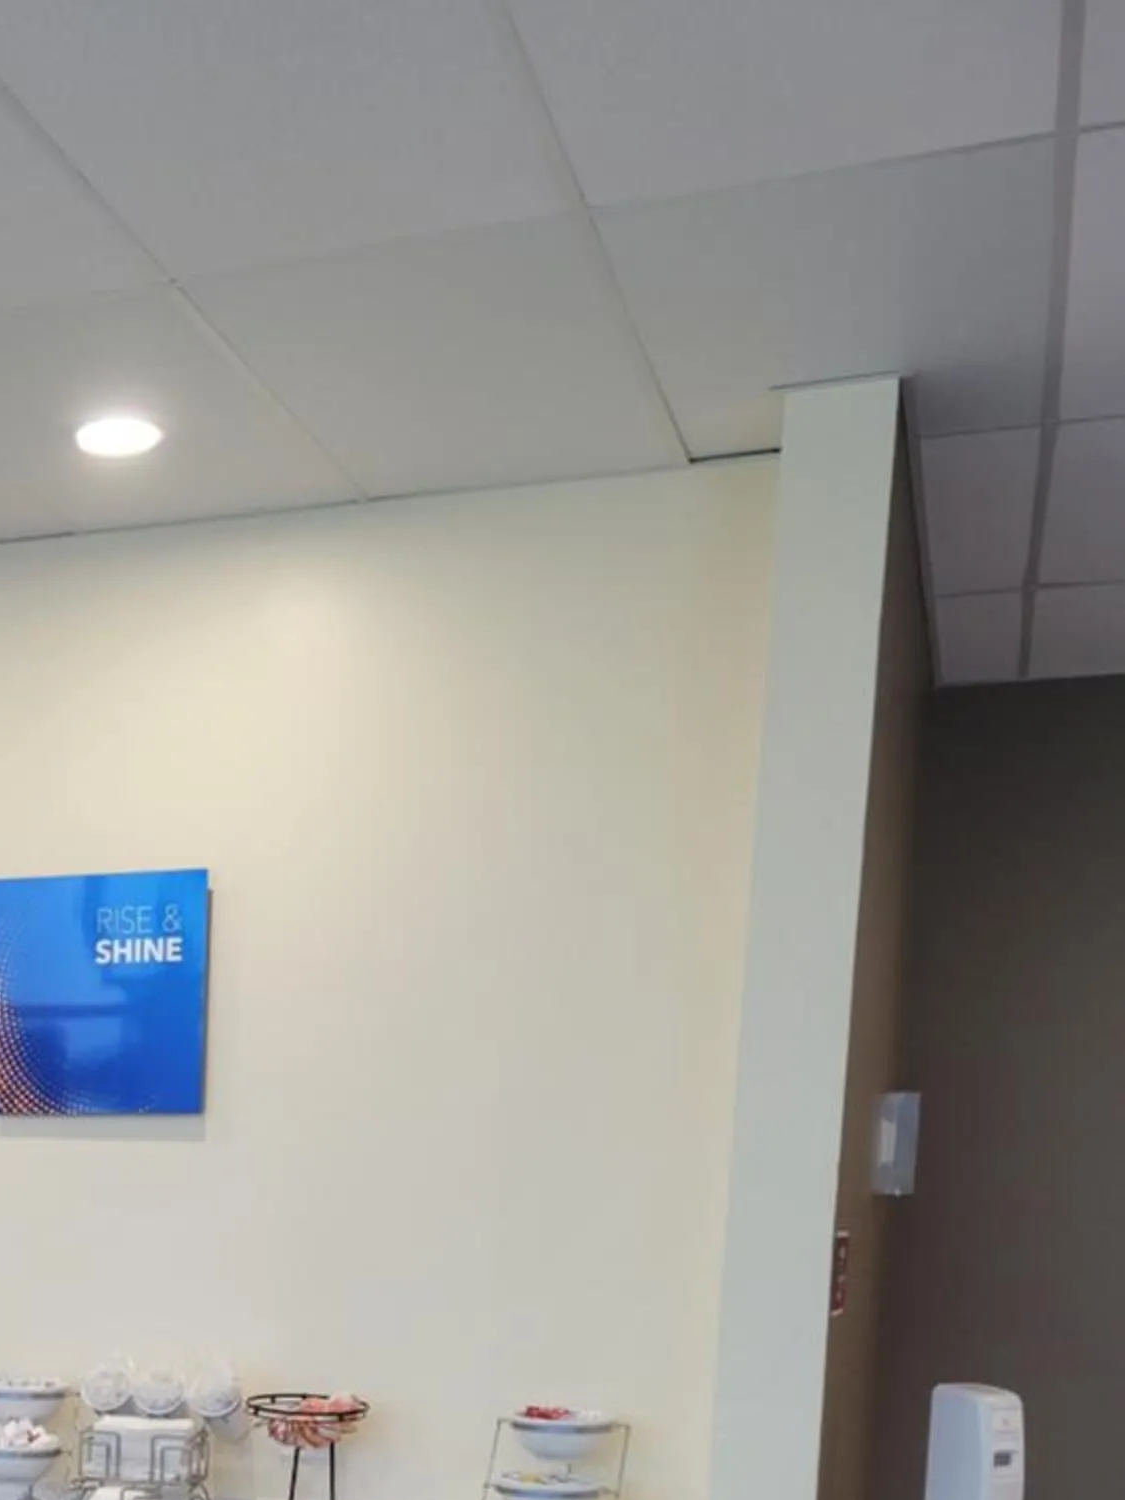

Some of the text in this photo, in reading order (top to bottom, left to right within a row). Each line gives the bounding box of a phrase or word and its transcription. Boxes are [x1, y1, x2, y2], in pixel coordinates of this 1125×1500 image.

[96, 903, 183, 934] RISE &
[95, 936, 184, 964] SHINE
